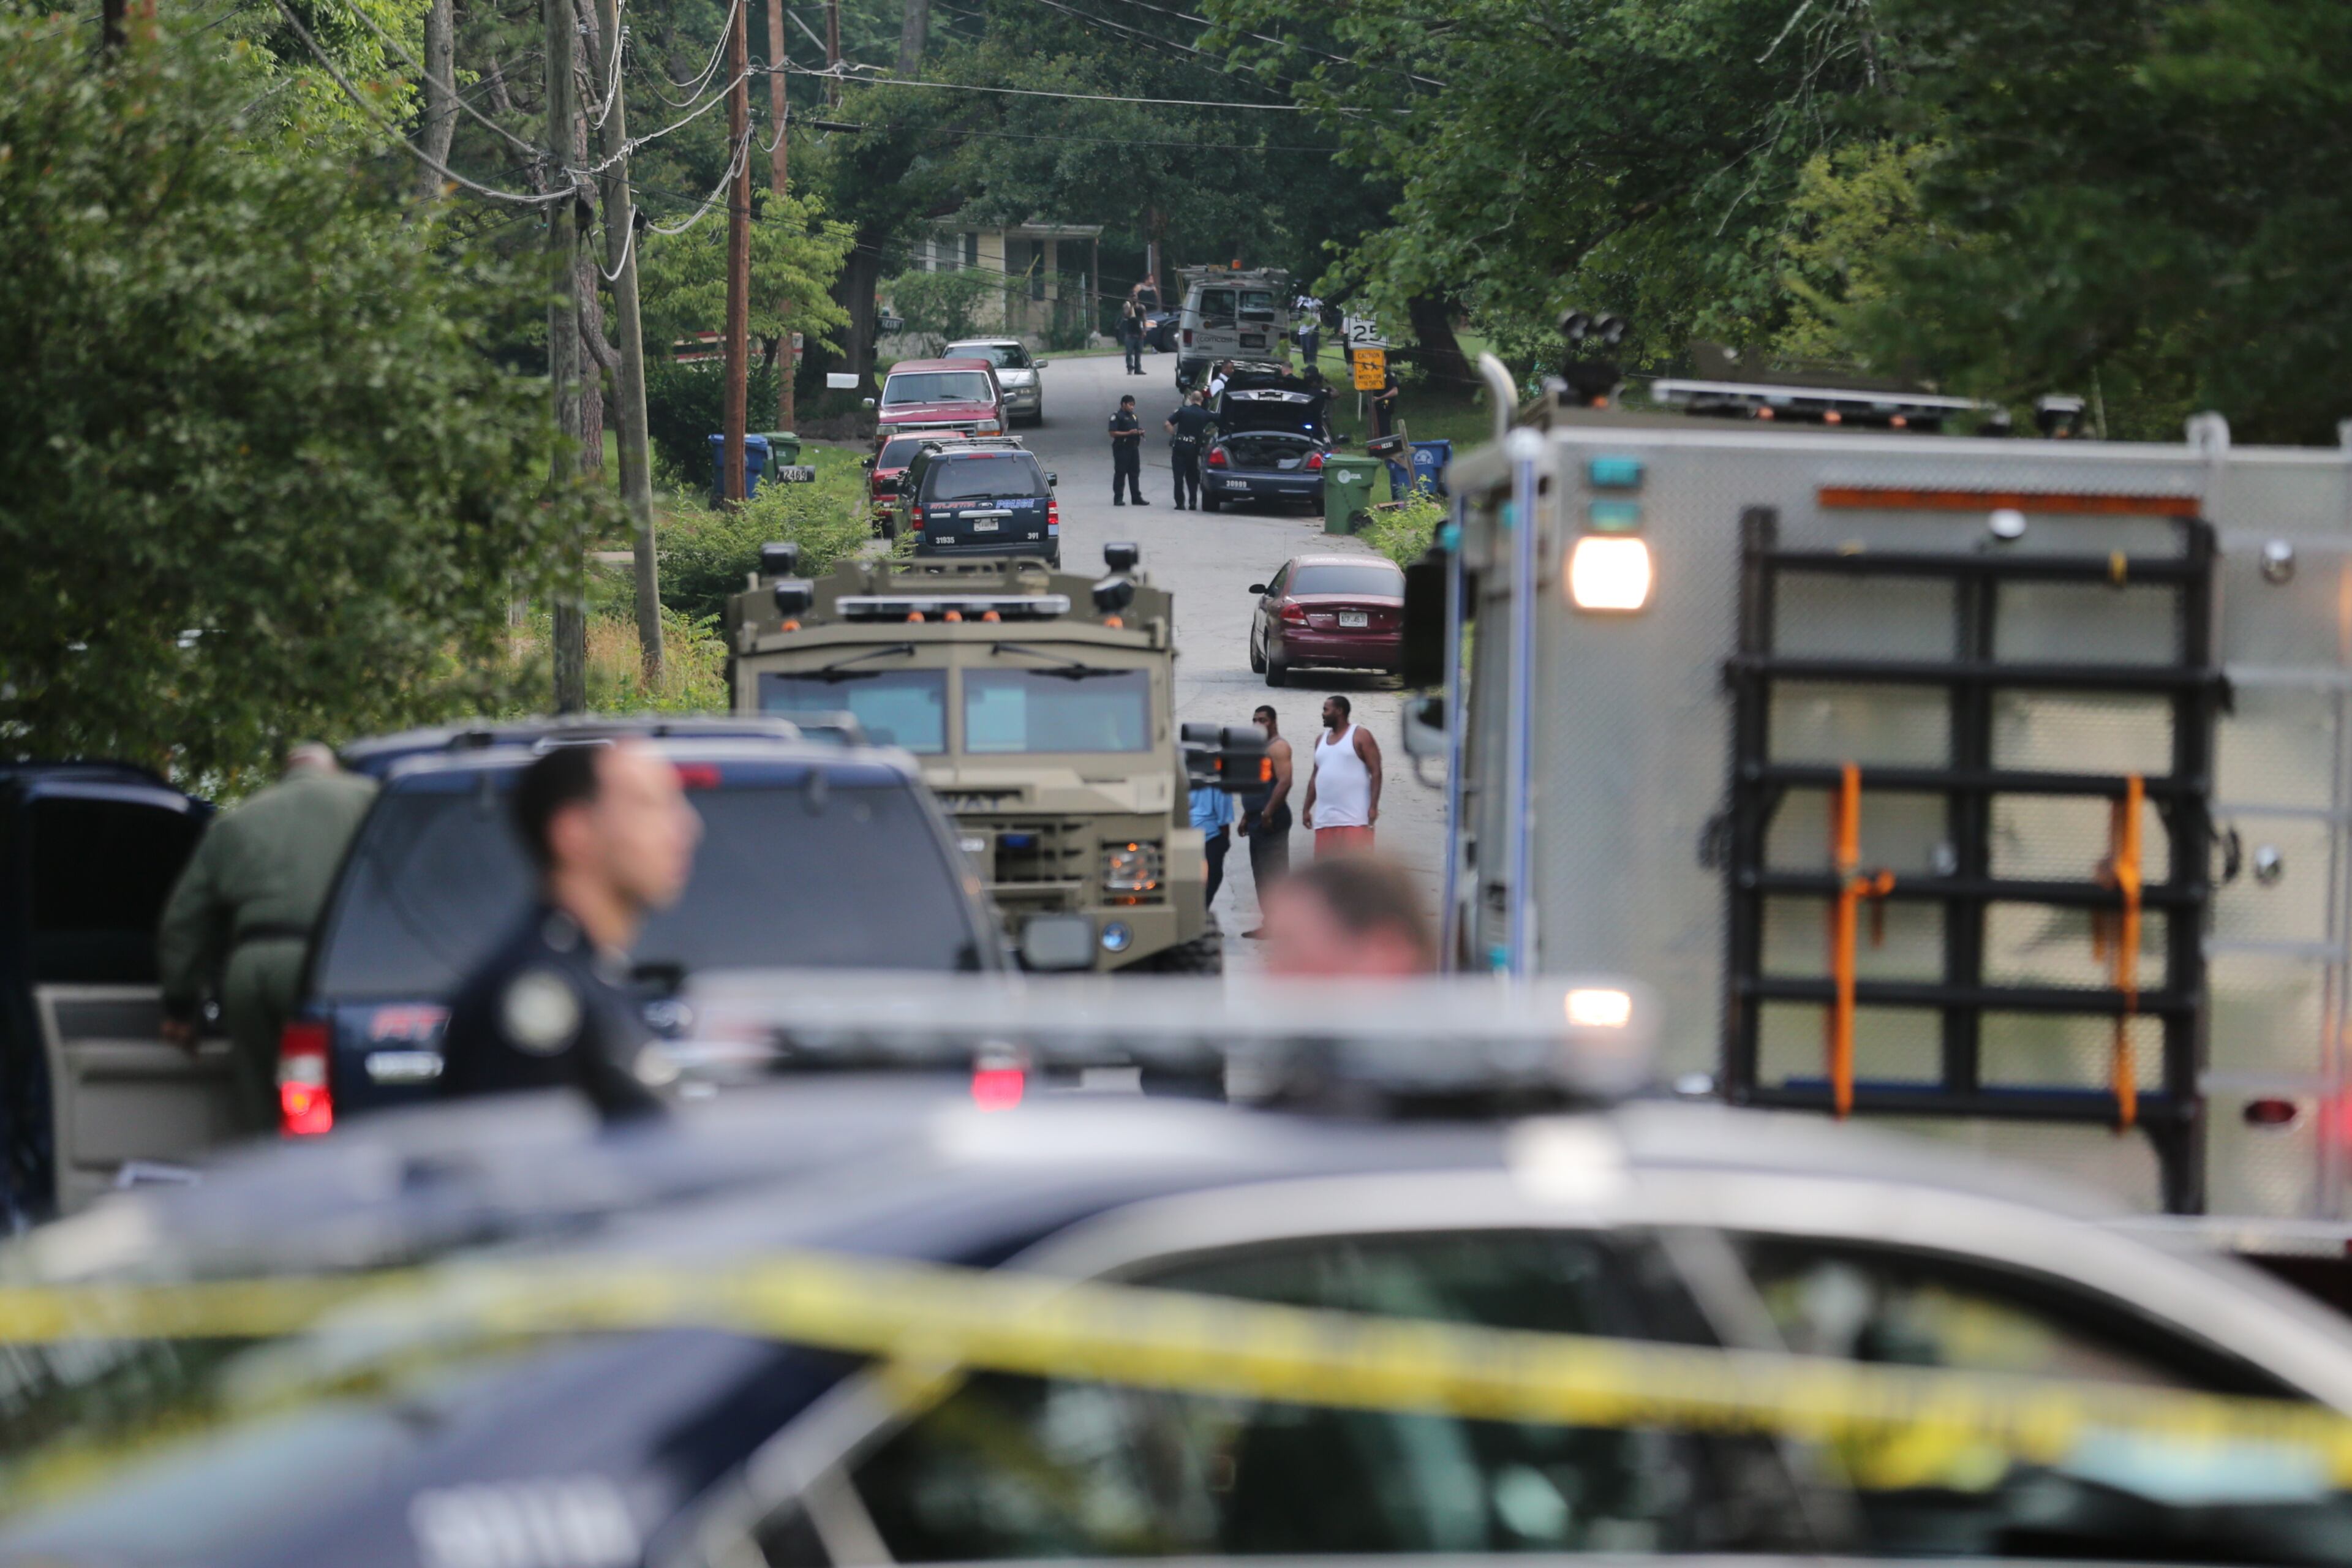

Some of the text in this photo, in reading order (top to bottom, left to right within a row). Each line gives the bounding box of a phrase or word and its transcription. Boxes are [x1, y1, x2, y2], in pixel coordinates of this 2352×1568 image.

[1354, 325, 1382, 342] 25
[784, 469, 807, 480] 2469
[996, 499, 1035, 509] POLICE
